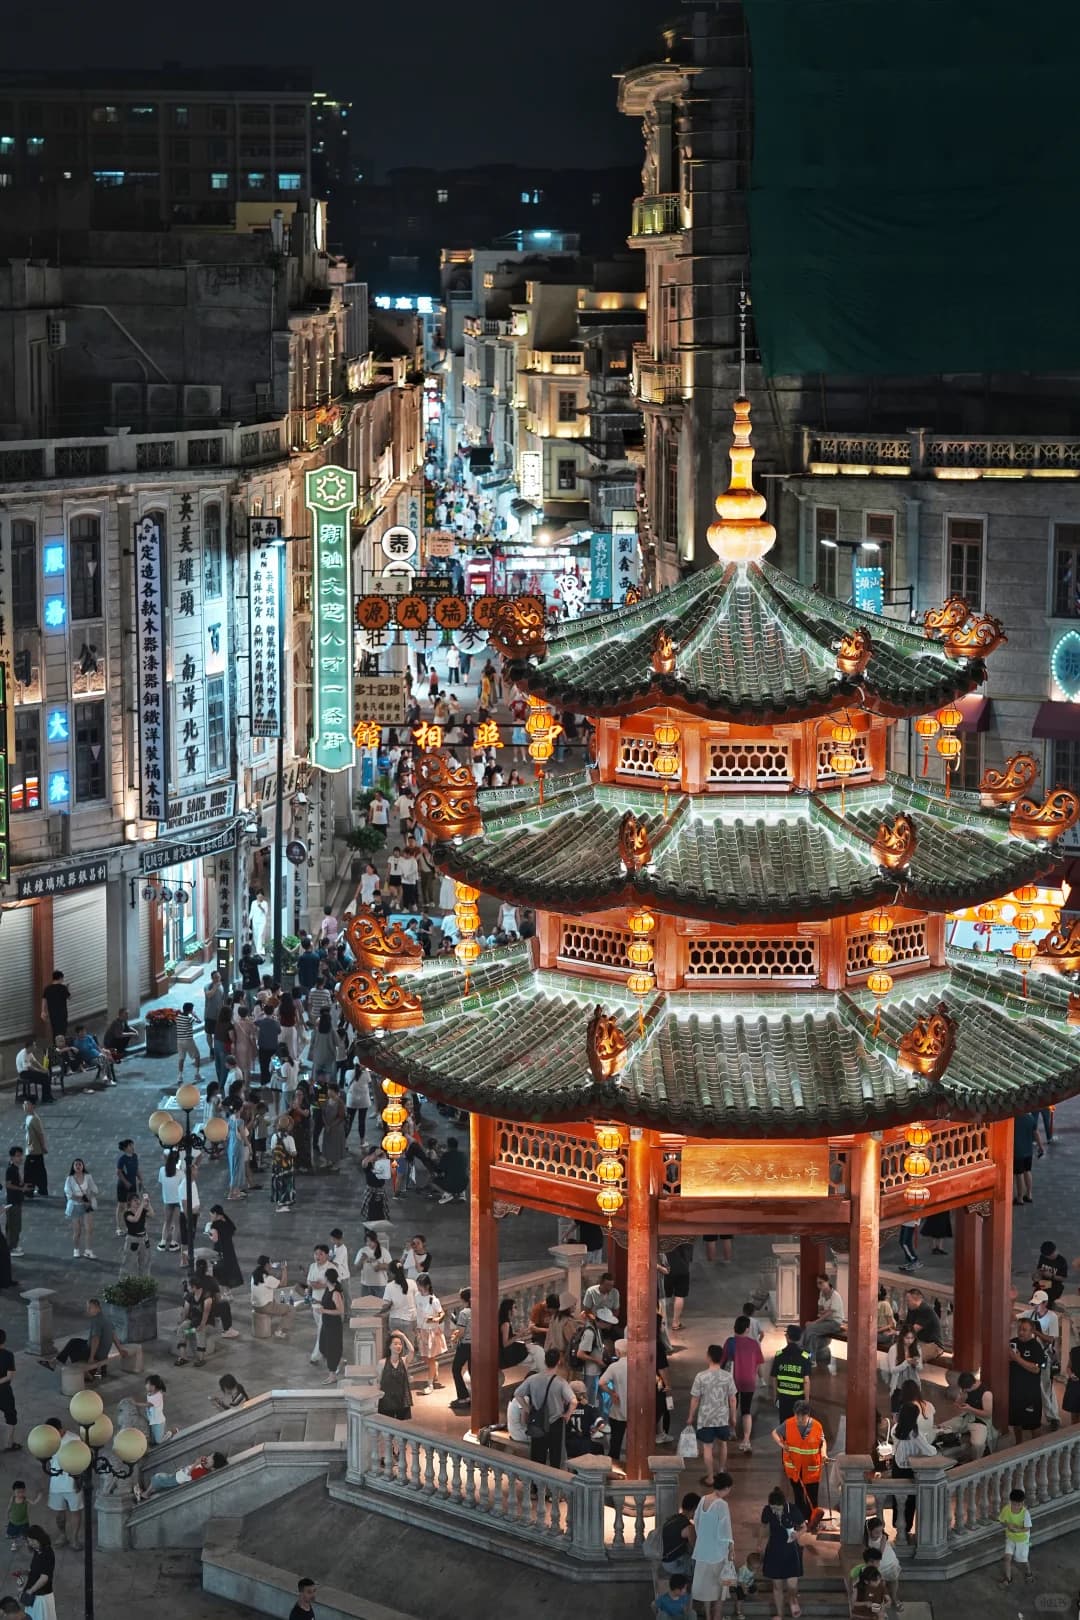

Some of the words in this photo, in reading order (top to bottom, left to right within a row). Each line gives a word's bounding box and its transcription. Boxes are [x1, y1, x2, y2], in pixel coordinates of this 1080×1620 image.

[181, 653, 199, 774] 南洋北貨
[320, 523, 345, 752] 潮汕文艺人才一条街
